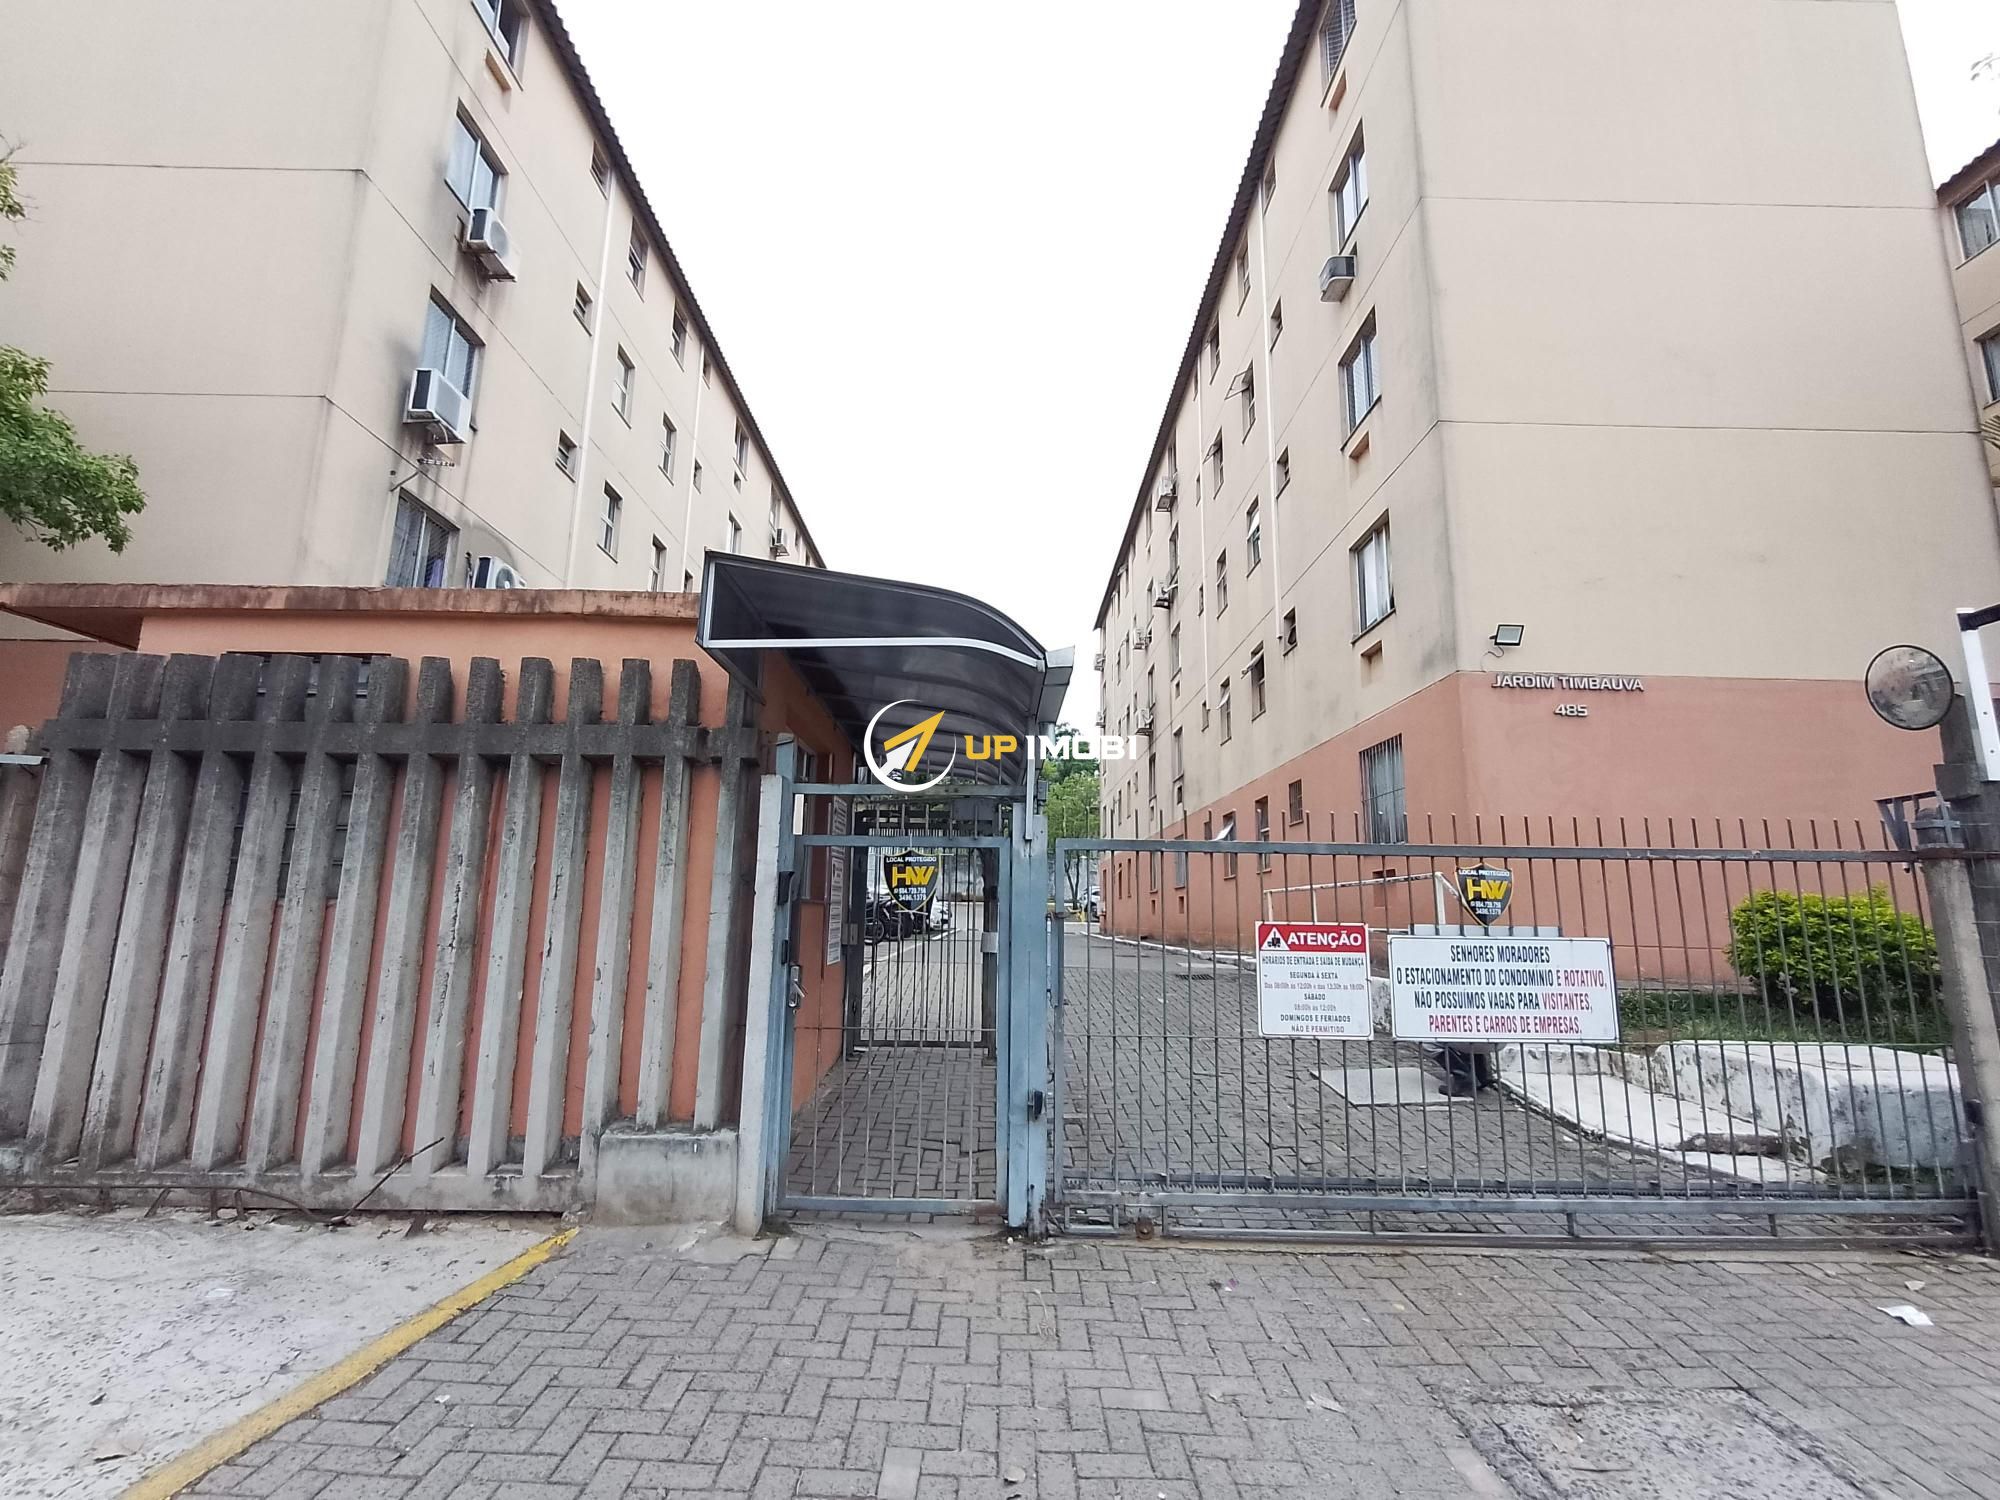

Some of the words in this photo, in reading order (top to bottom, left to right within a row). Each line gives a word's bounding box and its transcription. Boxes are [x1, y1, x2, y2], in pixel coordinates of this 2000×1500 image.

[1492, 675, 1555, 690] JARDIM
[1558, 676, 1644, 692] TIMBAUVA
[1554, 703, 1588, 717] 485
[892, 866, 935, 888] HW
[1466, 878, 1508, 900] HW
[1287, 930, 1362, 949] ATENÇÃO
[1286, 956, 1293, 965] DE
[1293, 956, 1315, 965] ENTRADA
[1334, 957, 1341, 966] DE
[1342, 957, 1365, 968] MUDANÇA
[1450, 945, 1495, 963] SENHORES
[1496, 945, 1551, 963] MORADORES
[1289, 971, 1315, 979] SEGUNDA
[1321, 972, 1338, 980] SEXTA
[1396, 967, 1402, 985] O
[1405, 967, 1482, 986] ESTACIONAMENTO
[1484, 968, 1496, 986] DO
[1414, 987, 1432, 1009] NÃO
[1487, 991, 1515, 1010] VAGAS
[1517, 992, 1541, 1010] PARA
[1541, 992, 1593, 1014] VISITANTES,
[1280, 1014, 1313, 1022] DOMINGOS
[1315, 1014, 1320, 1022] E
[1320, 1015, 1351, 1023] FERIADOS
[1428, 1014, 1473, 1033] PARENTES
[1475, 1015, 1481, 1033] E
[1483, 1015, 1518, 1034] CARROS
[1519, 1016, 1531, 1034] DE
[1534, 1016, 1582, 1035] EMPRESAS.
[1291, 1024, 1304, 1032] NÃO
